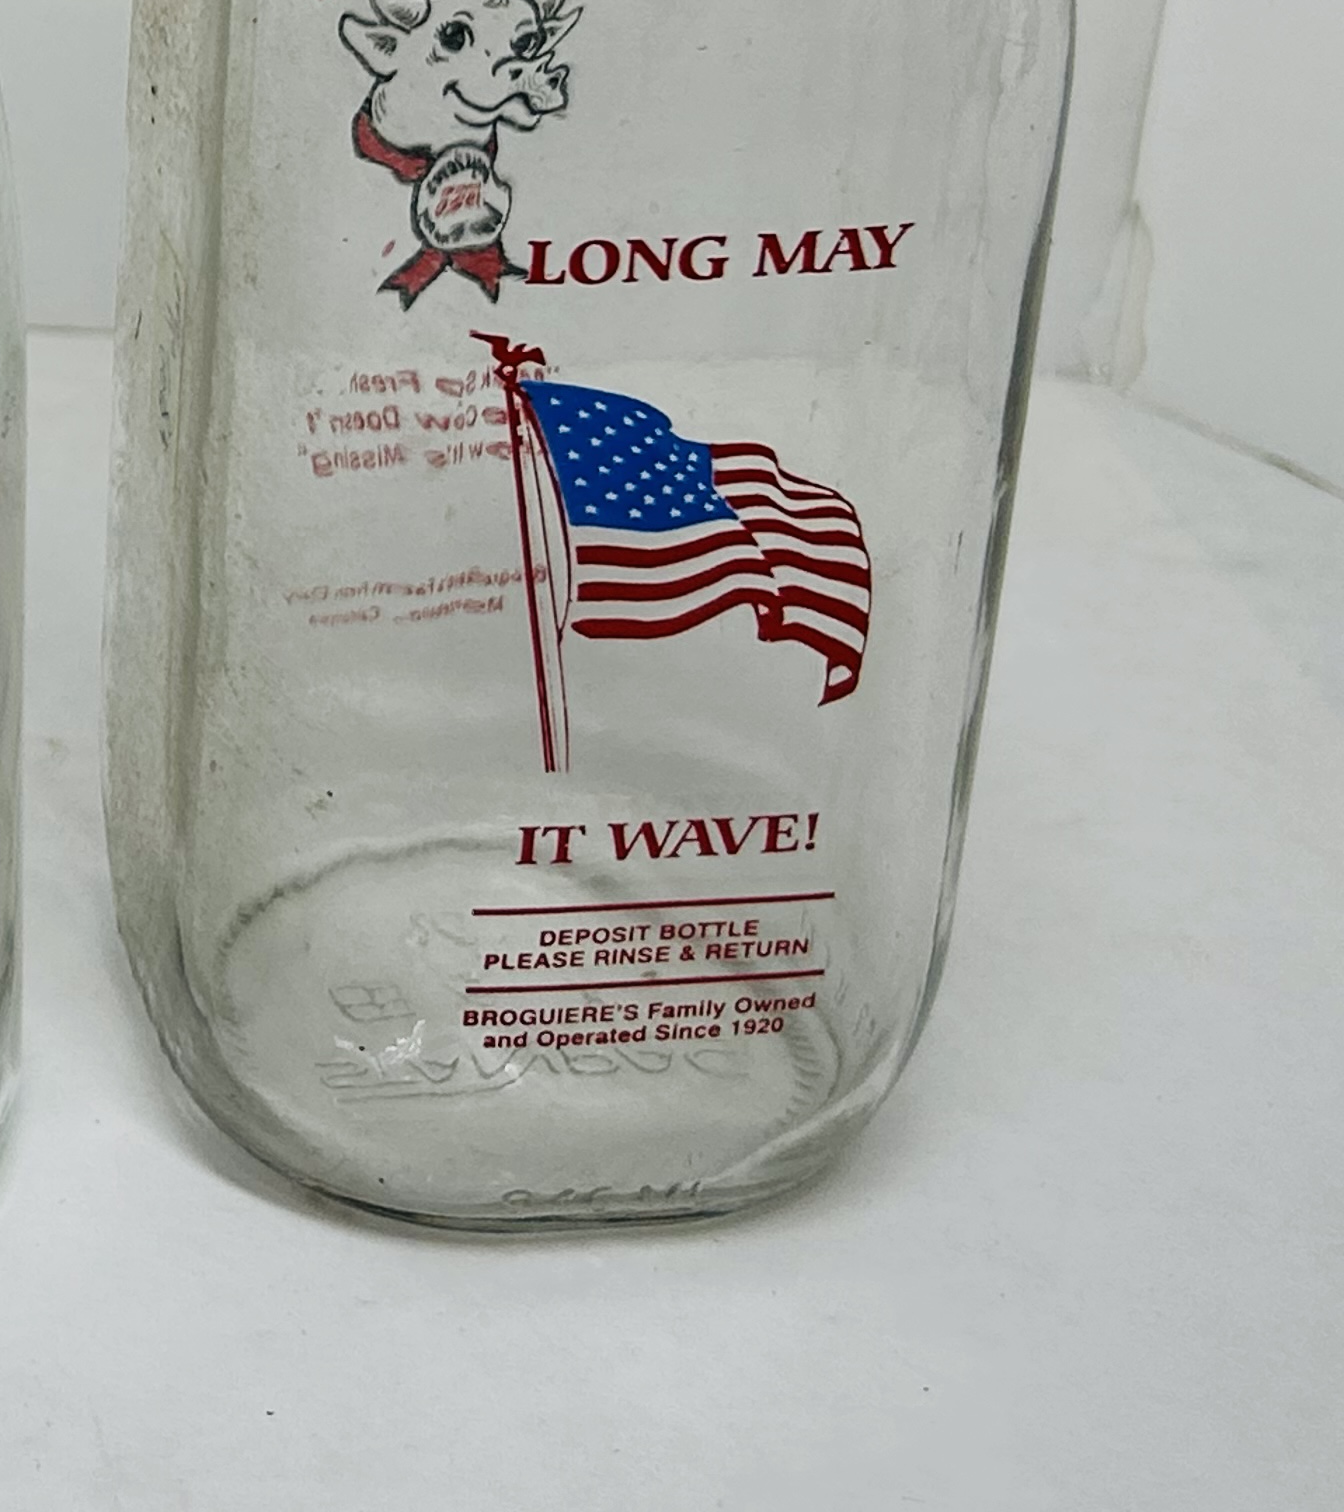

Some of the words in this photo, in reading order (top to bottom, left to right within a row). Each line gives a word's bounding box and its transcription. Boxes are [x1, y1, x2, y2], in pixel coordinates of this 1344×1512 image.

[524, 235, 729, 286] LONG
[752, 222, 915, 277] MAY
[515, 825, 586, 865] IT
[608, 812, 819, 861] WAVE!
[540, 926, 651, 946] DEPOSIT
[660, 919, 760, 940] BOTTLE
[484, 952, 586, 970] PLEASE
[595, 946, 669, 964] RINSE
[680, 944, 695, 962] &
[705, 939, 809, 961] RETURN
[463, 1002, 639, 1027] BROGUIERE'S
[648, 999, 726, 1020] Family
[734, 993, 817, 1014] Owned
[484, 1033, 528, 1048] and
[537, 1026, 647, 1050] Operated
[655, 1022, 721, 1041] Since
[732, 1018, 783, 1036] 1920
